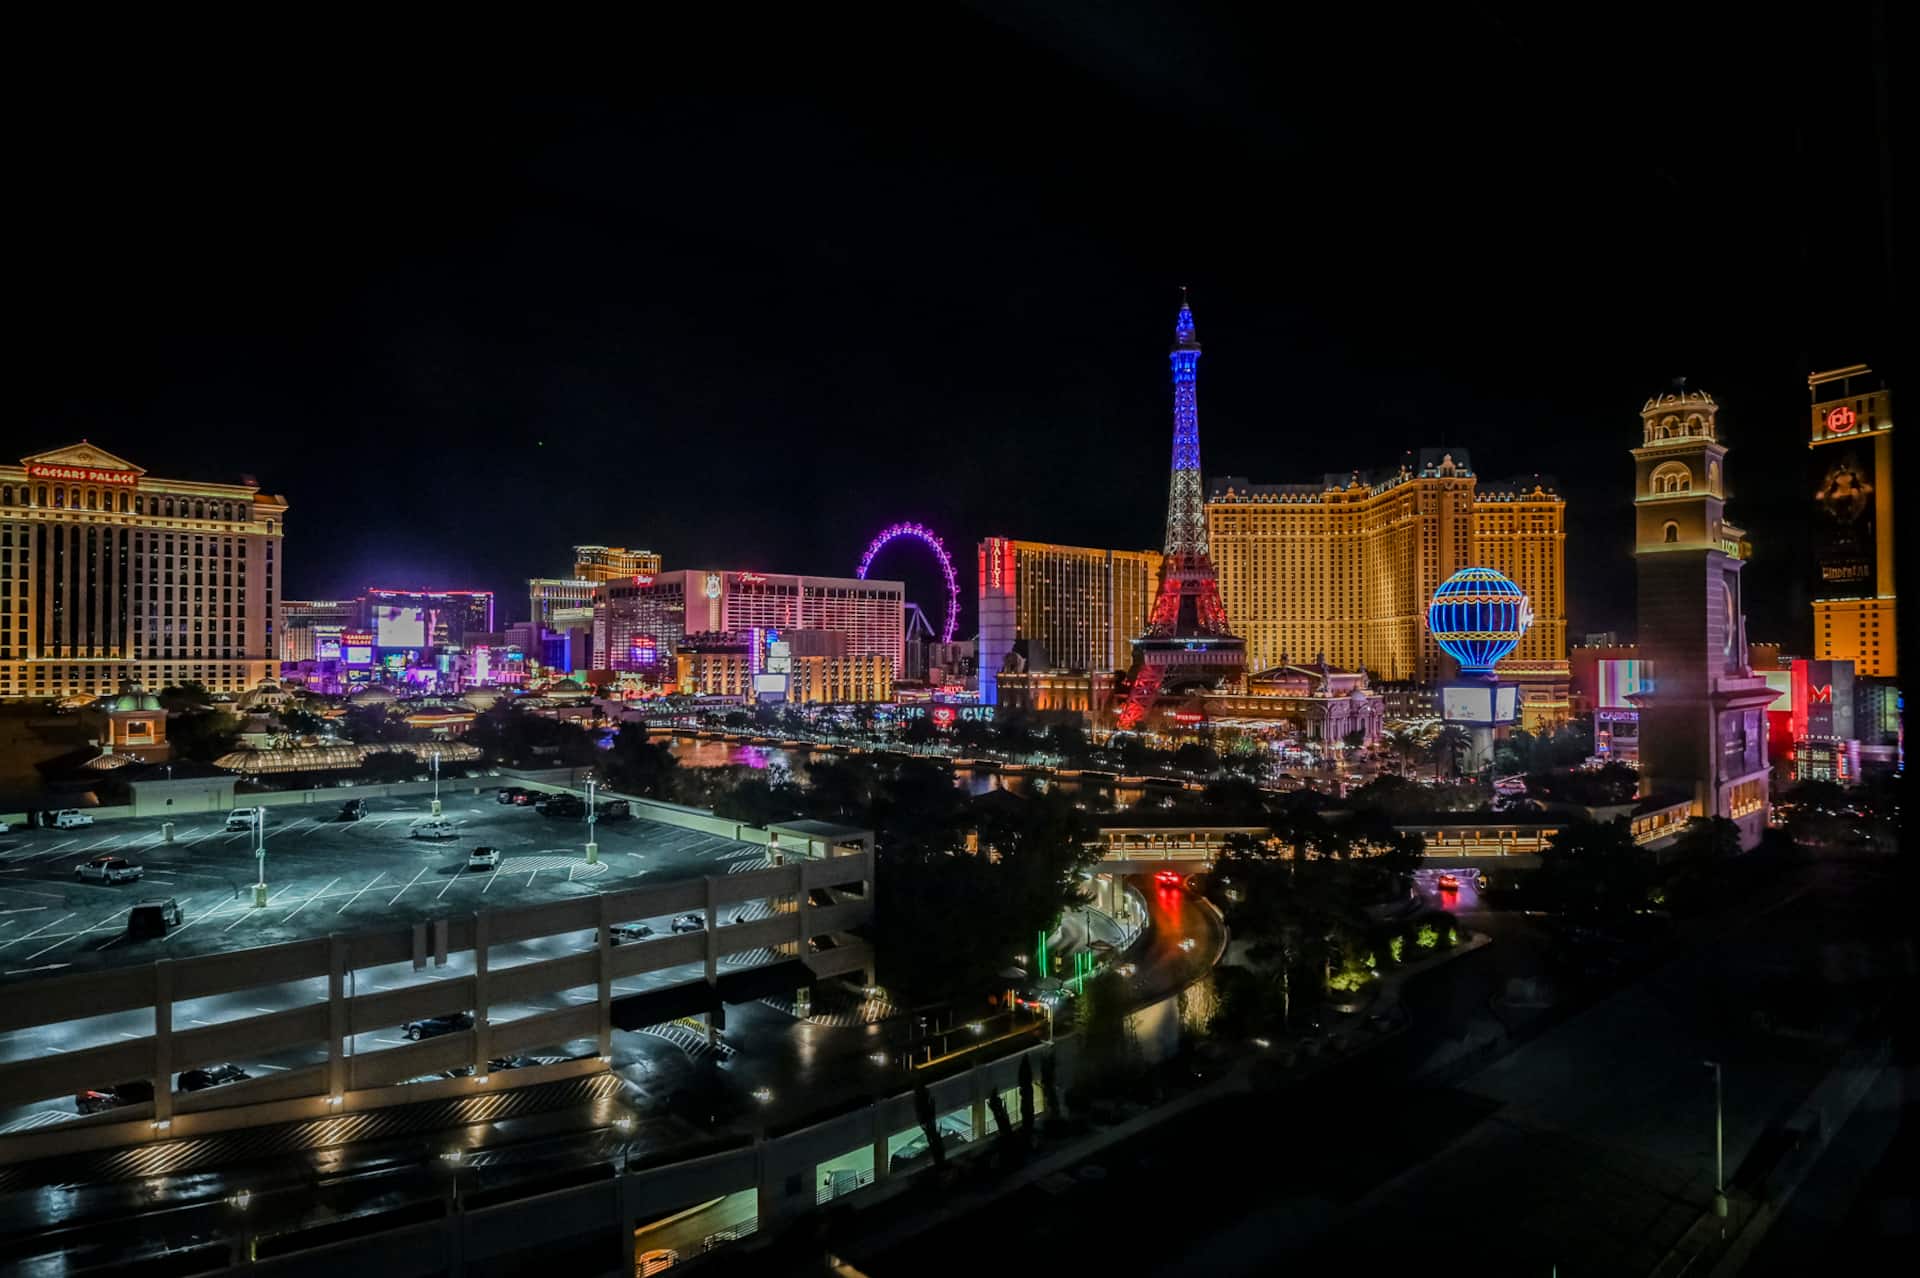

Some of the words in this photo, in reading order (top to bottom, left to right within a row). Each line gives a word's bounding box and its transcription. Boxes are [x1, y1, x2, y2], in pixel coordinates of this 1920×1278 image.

[33, 467, 87, 480] CAESARS
[88, 472, 134, 484] PALACE
[961, 707, 995, 722] CVS
